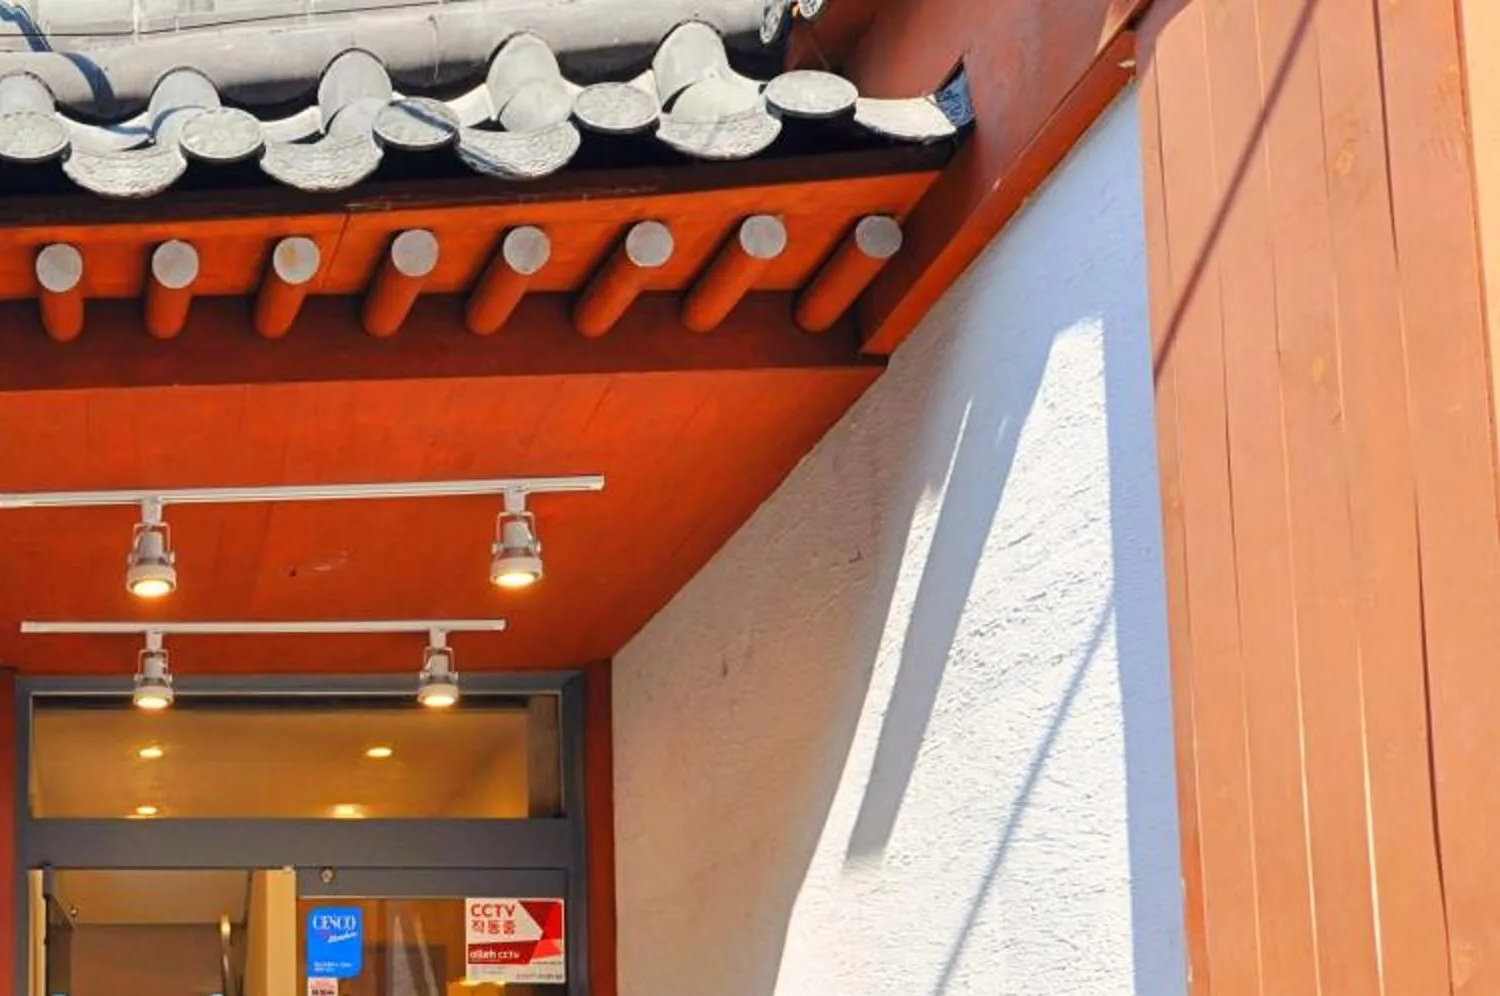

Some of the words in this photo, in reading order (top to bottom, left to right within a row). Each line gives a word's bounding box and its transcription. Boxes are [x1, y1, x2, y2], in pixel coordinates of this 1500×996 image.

[471, 903, 516, 917] CCTV
[312, 915, 357, 930] CESCO
[471, 919, 516, 935] 작동중
